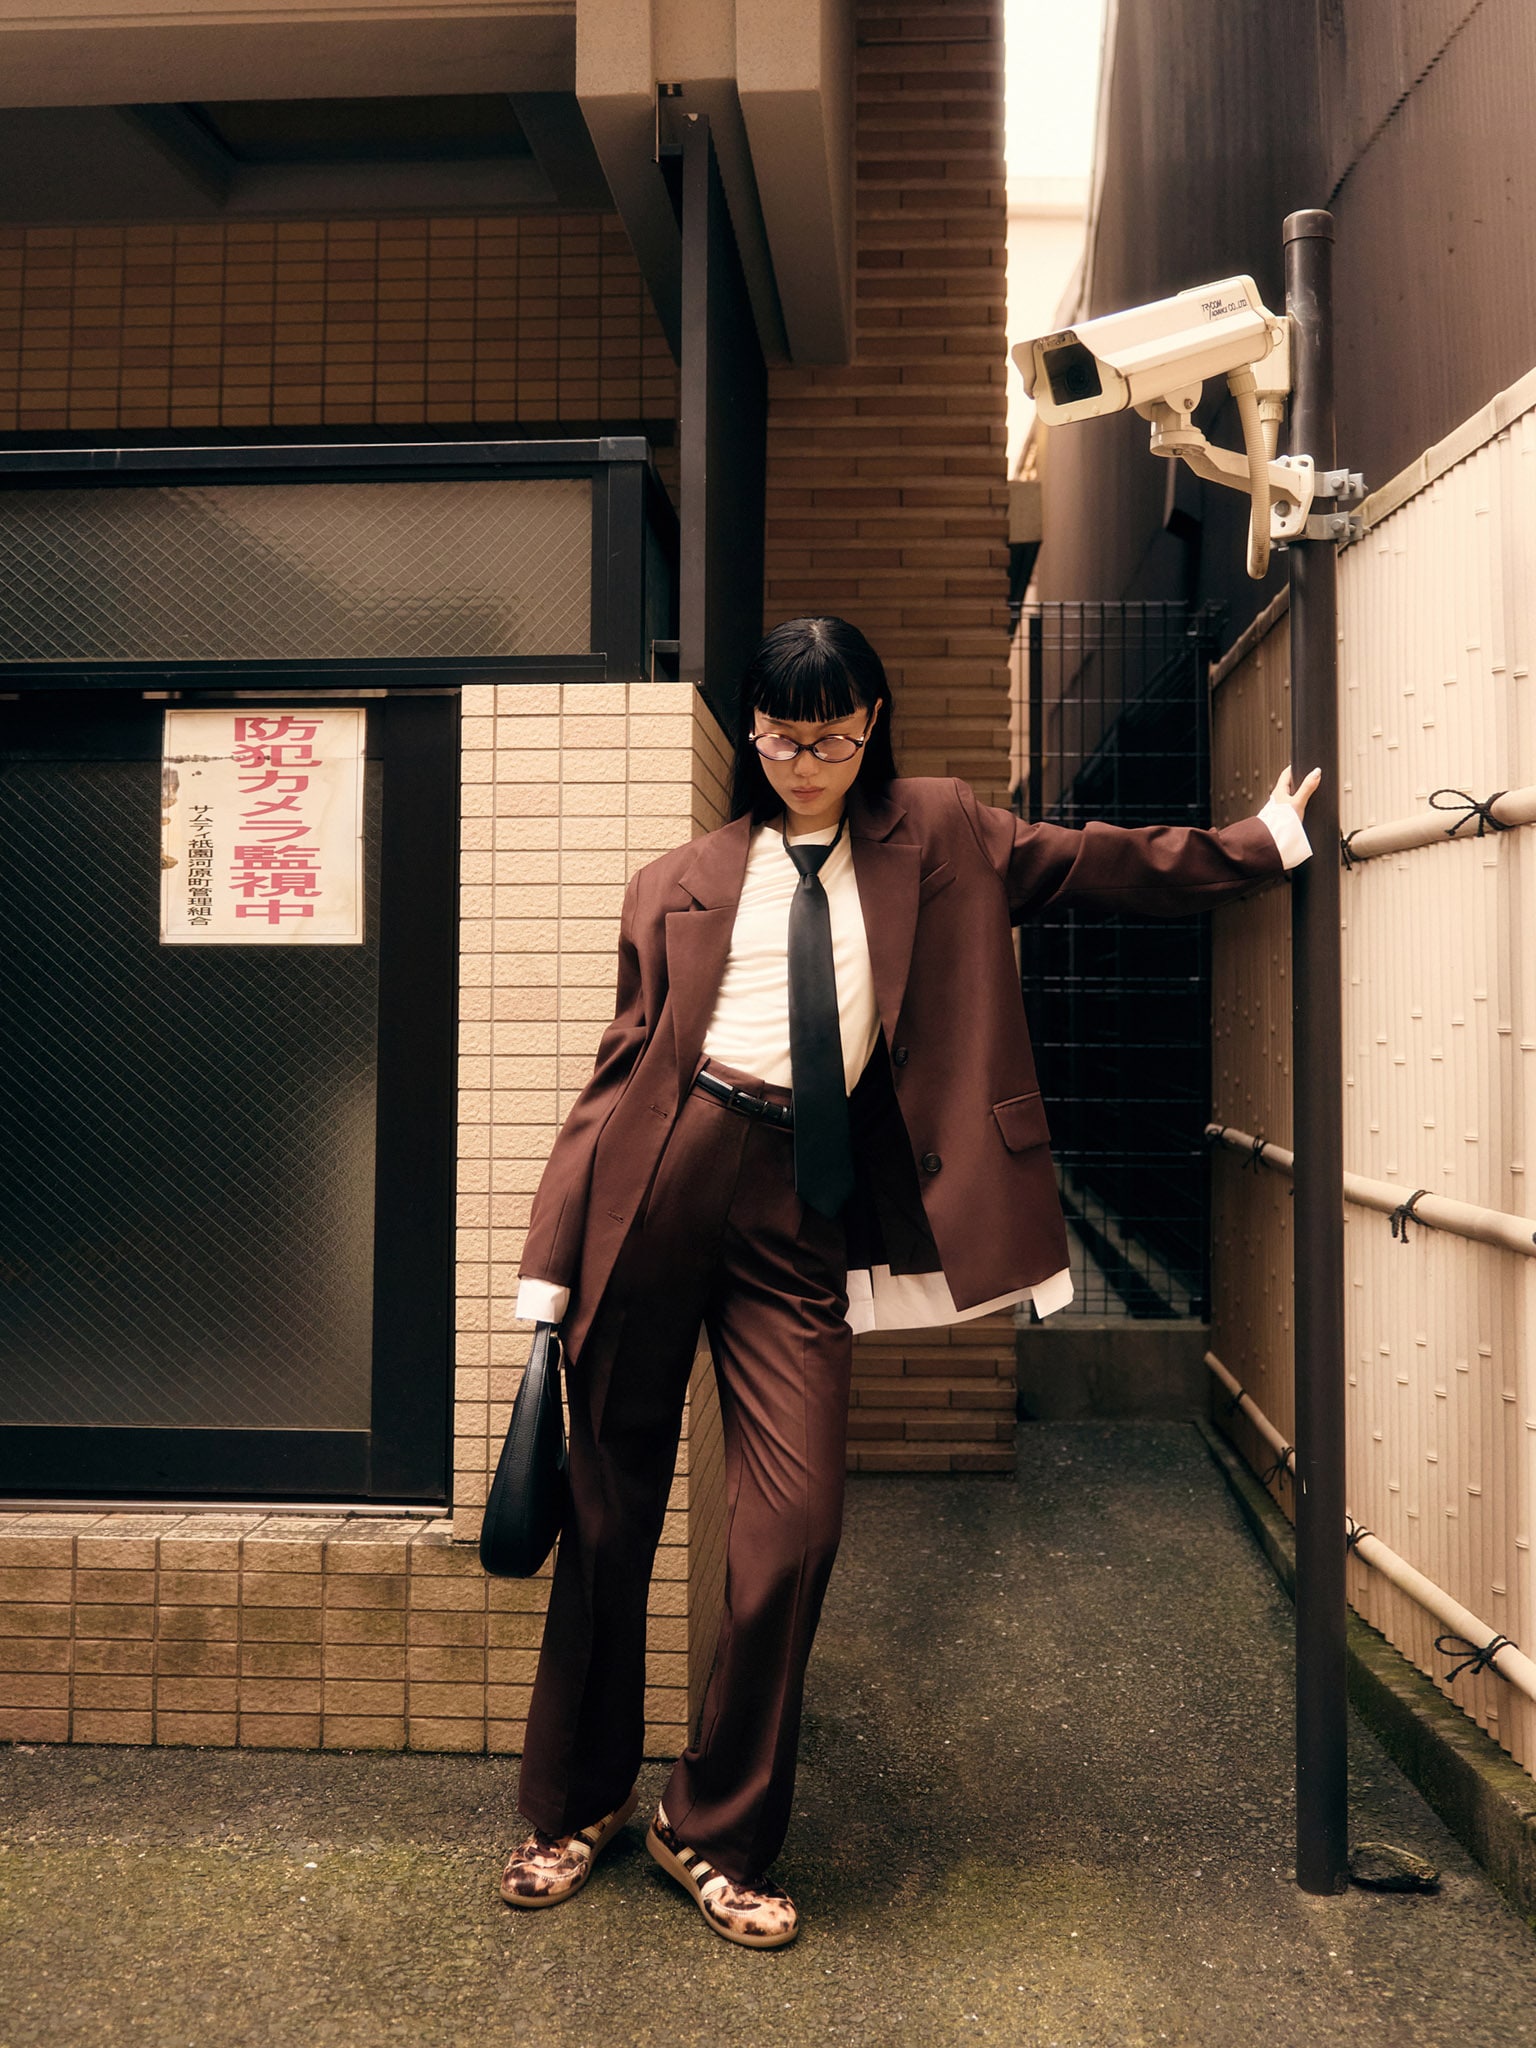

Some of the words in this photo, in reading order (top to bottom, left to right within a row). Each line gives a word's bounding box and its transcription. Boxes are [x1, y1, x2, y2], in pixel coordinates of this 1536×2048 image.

[228, 715, 324, 925] 防犯カメラ監視中
